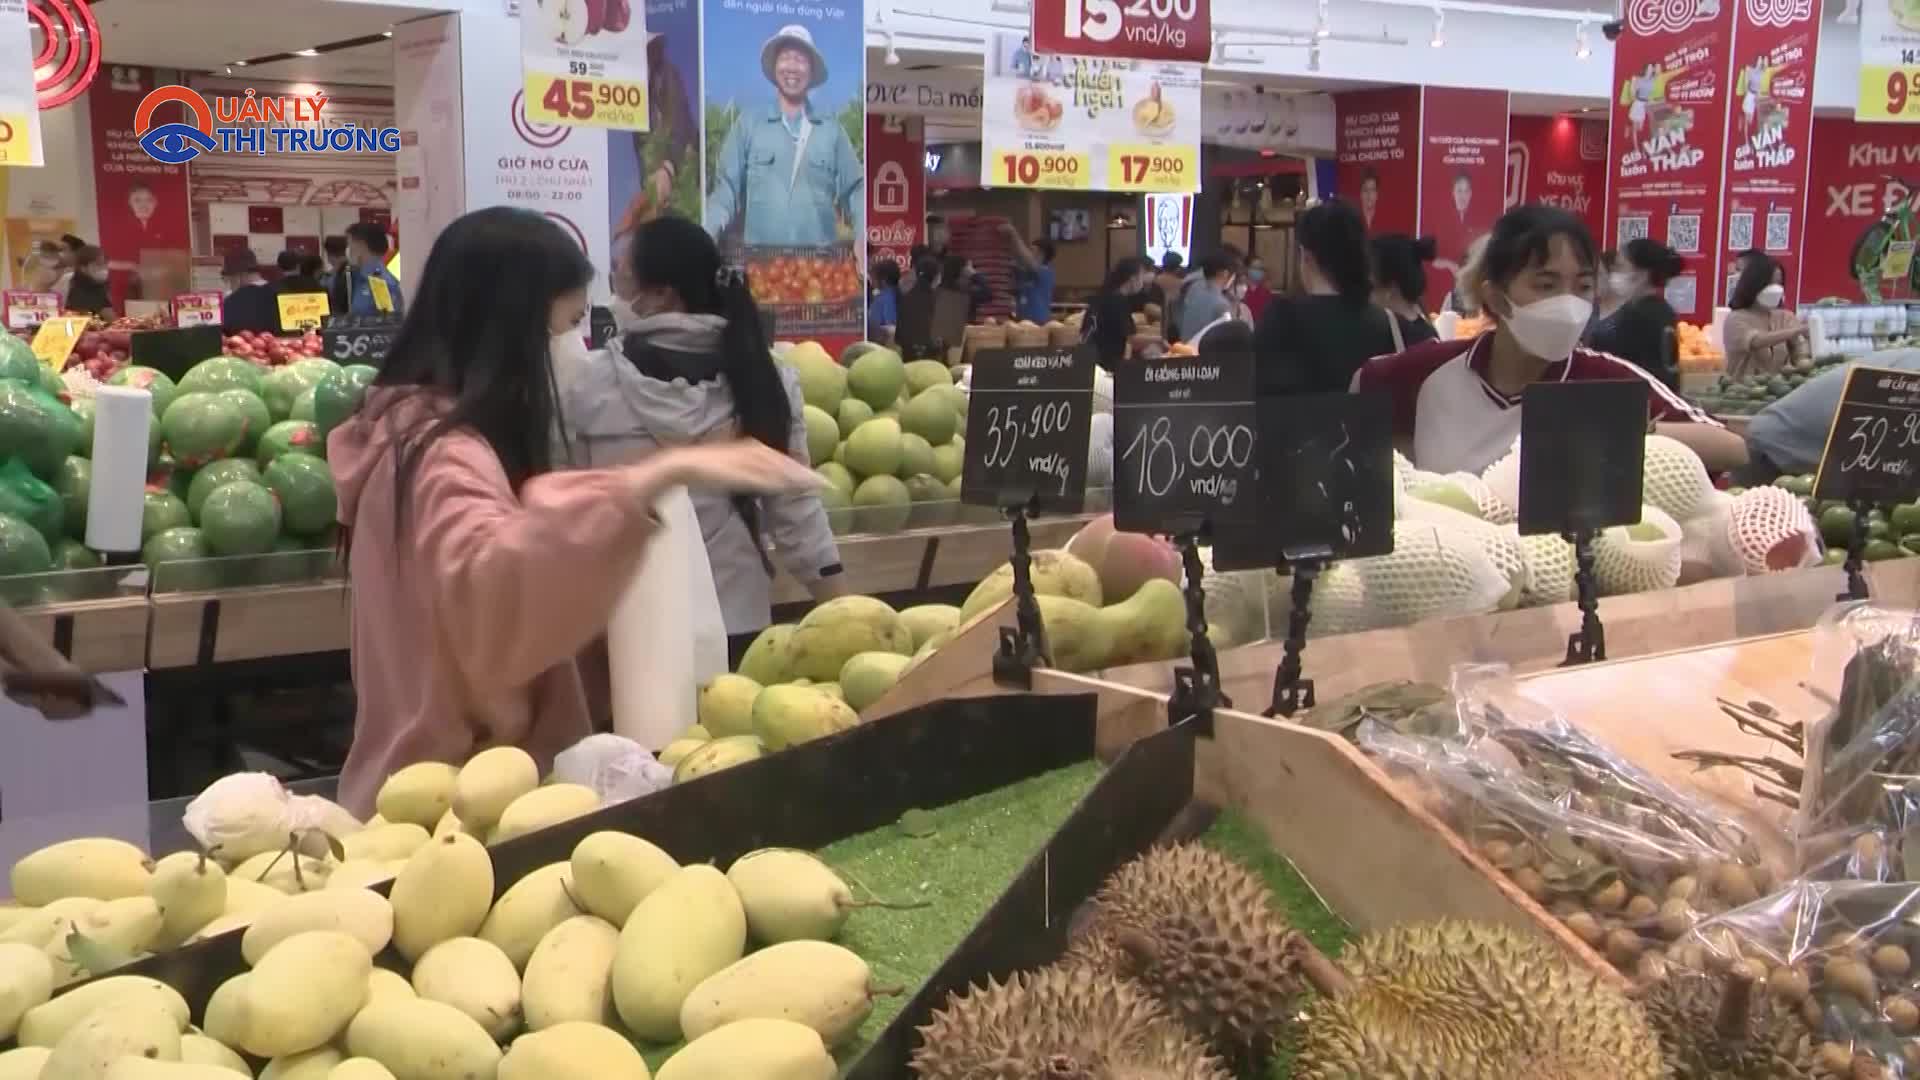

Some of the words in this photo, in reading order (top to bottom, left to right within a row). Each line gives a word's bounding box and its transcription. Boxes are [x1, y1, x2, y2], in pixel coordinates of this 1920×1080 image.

[1124, 23, 1187, 49] vnd/kg
[1848, 142, 1898, 168] Khu
[1825, 183, 1876, 217] XE
